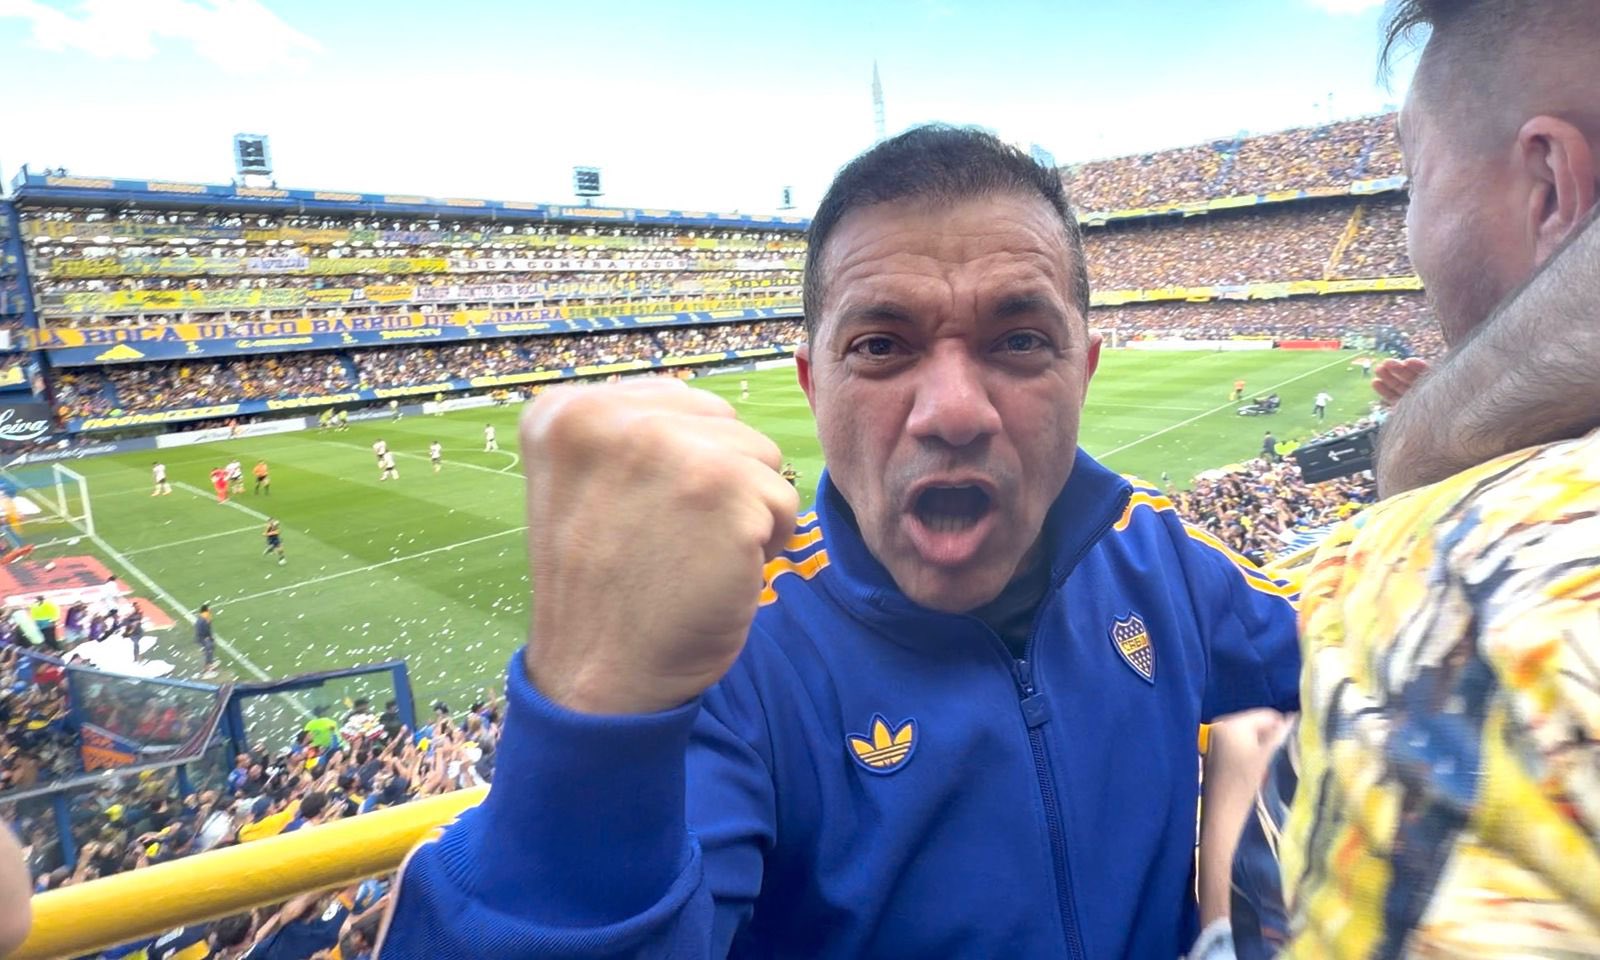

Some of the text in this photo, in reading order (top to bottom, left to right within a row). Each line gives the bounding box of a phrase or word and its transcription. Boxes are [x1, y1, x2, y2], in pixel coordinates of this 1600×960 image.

[568, 303, 626, 318] SIEMPRE
[83, 325, 182, 344] BOCA
[312, 315, 412, 333] BARRIO
[424, 315, 456, 328] DE
